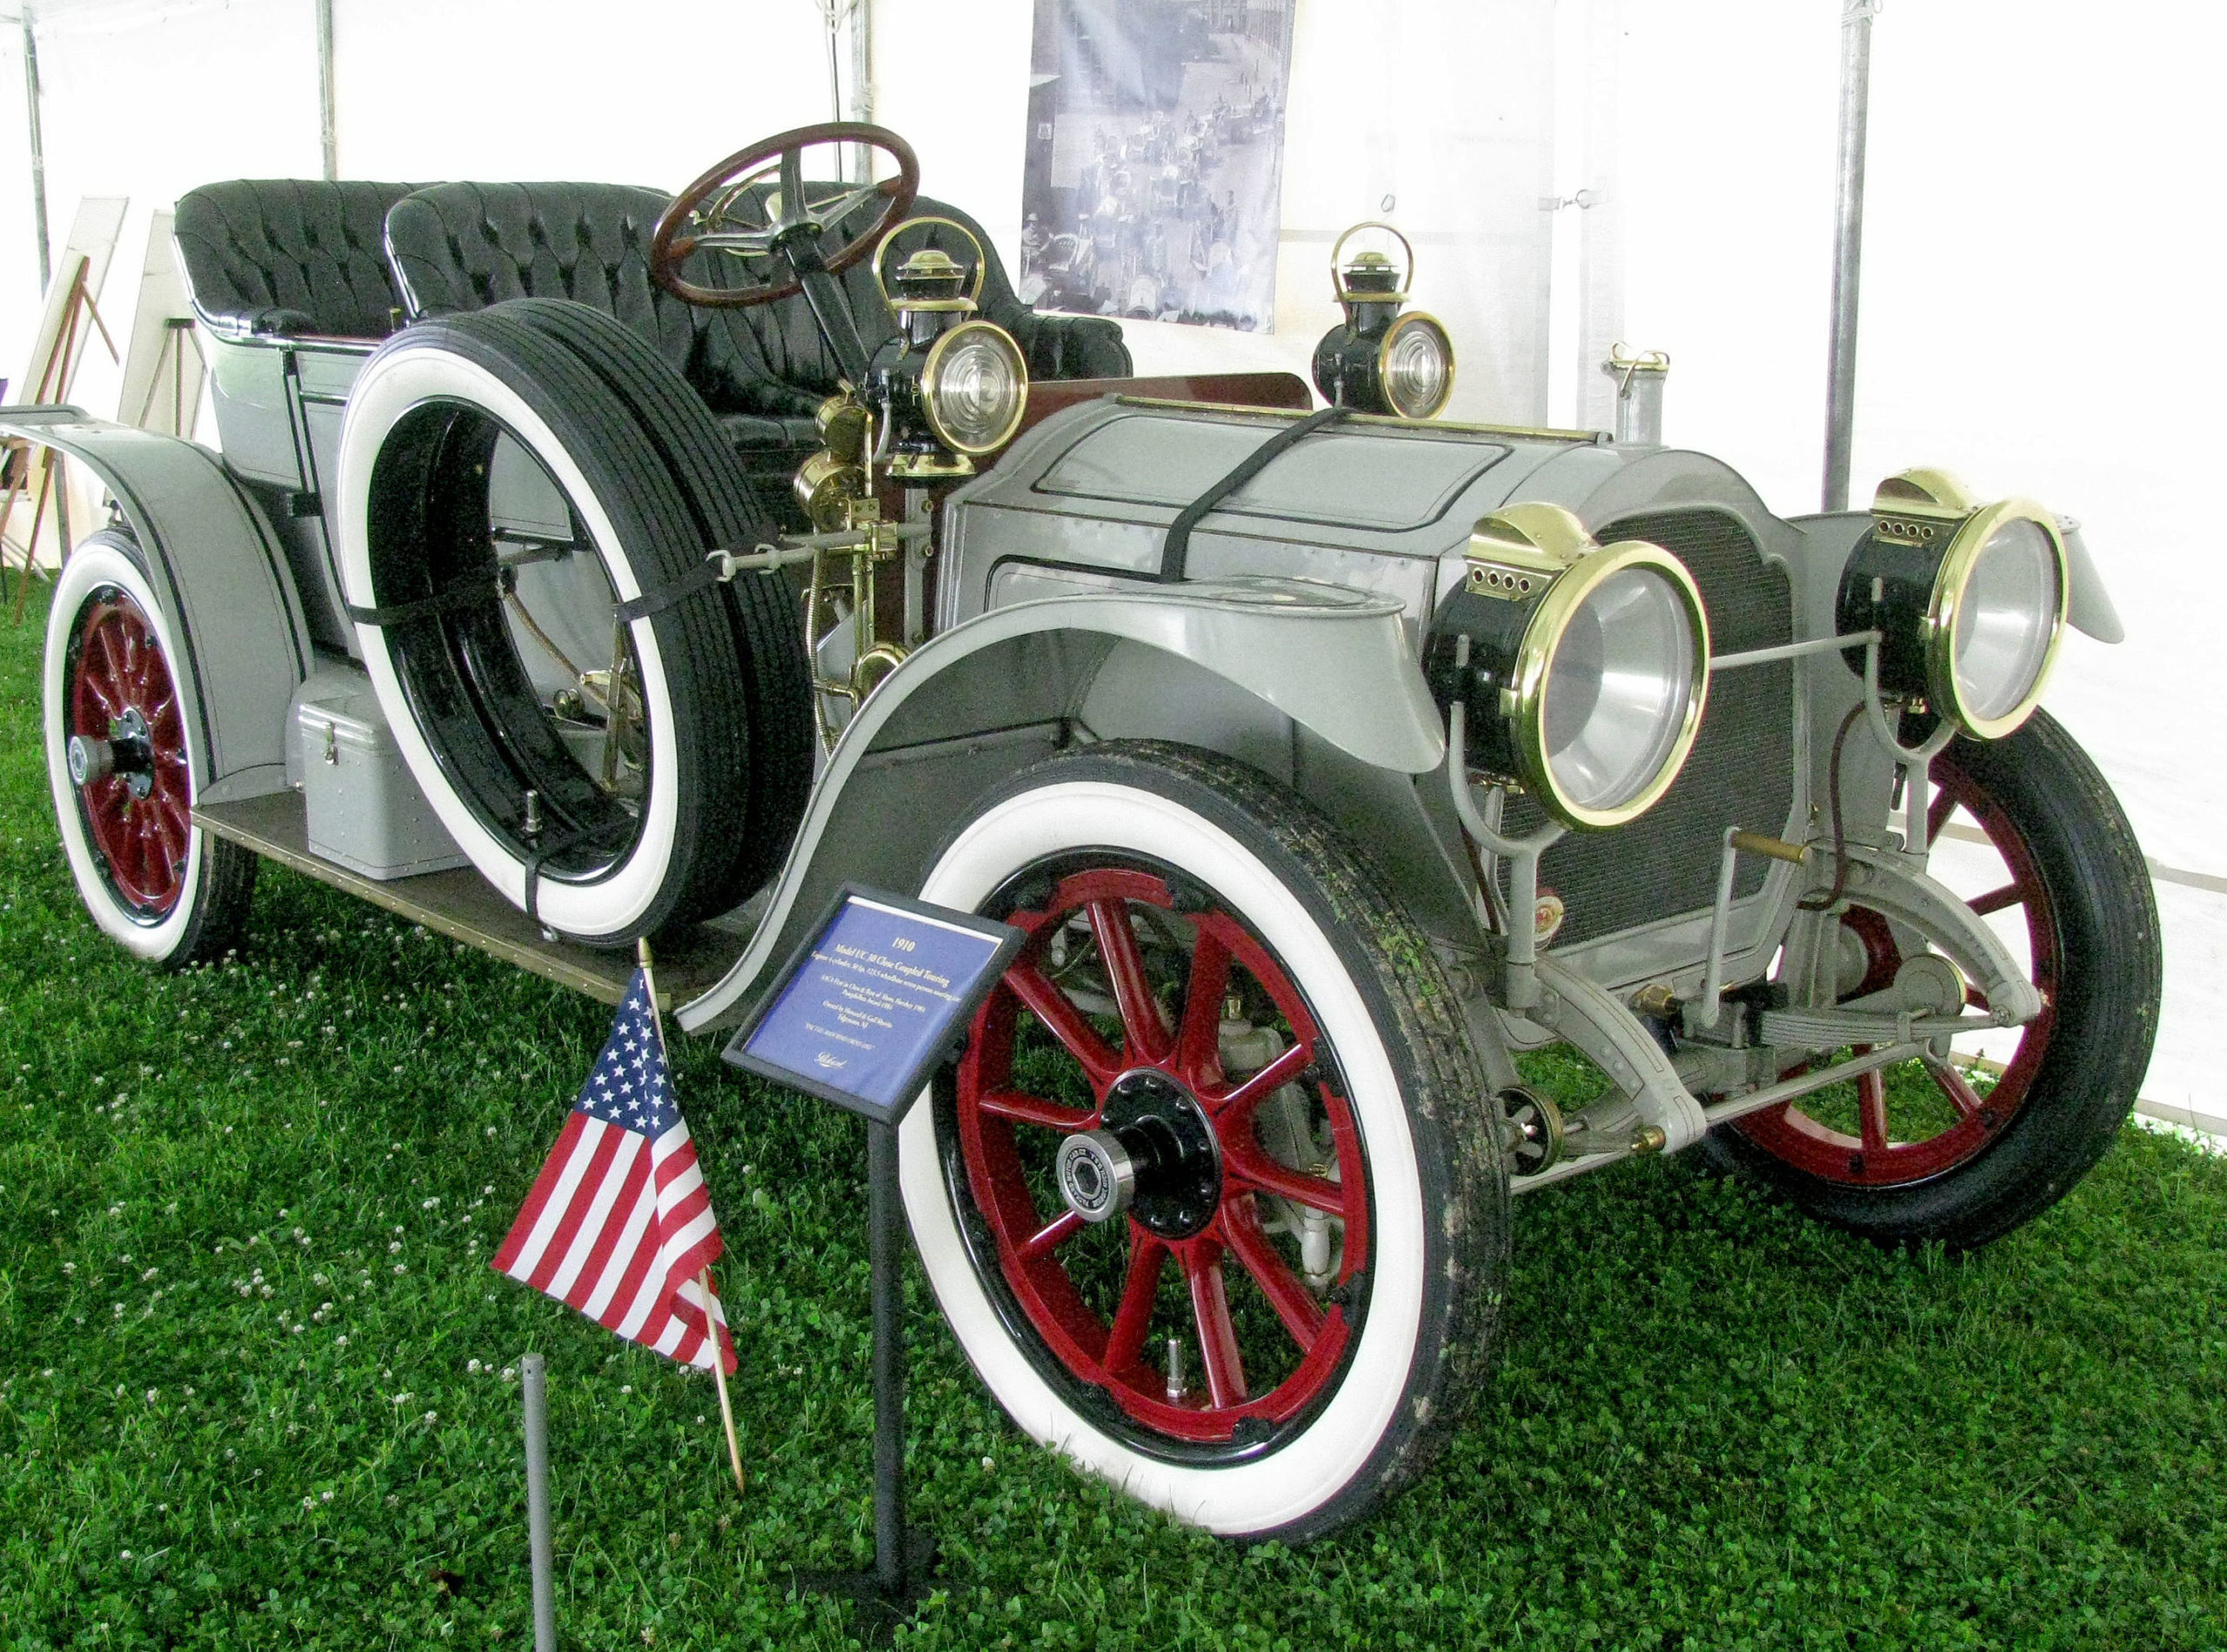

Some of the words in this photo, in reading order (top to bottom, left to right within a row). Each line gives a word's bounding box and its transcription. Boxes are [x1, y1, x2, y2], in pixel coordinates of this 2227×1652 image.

[892, 937, 916, 953] 1910
[834, 943, 855, 956] Model
[876, 956, 895, 969] Close
[894, 961, 926, 977] Coupled
[922, 969, 951, 988] Touring
